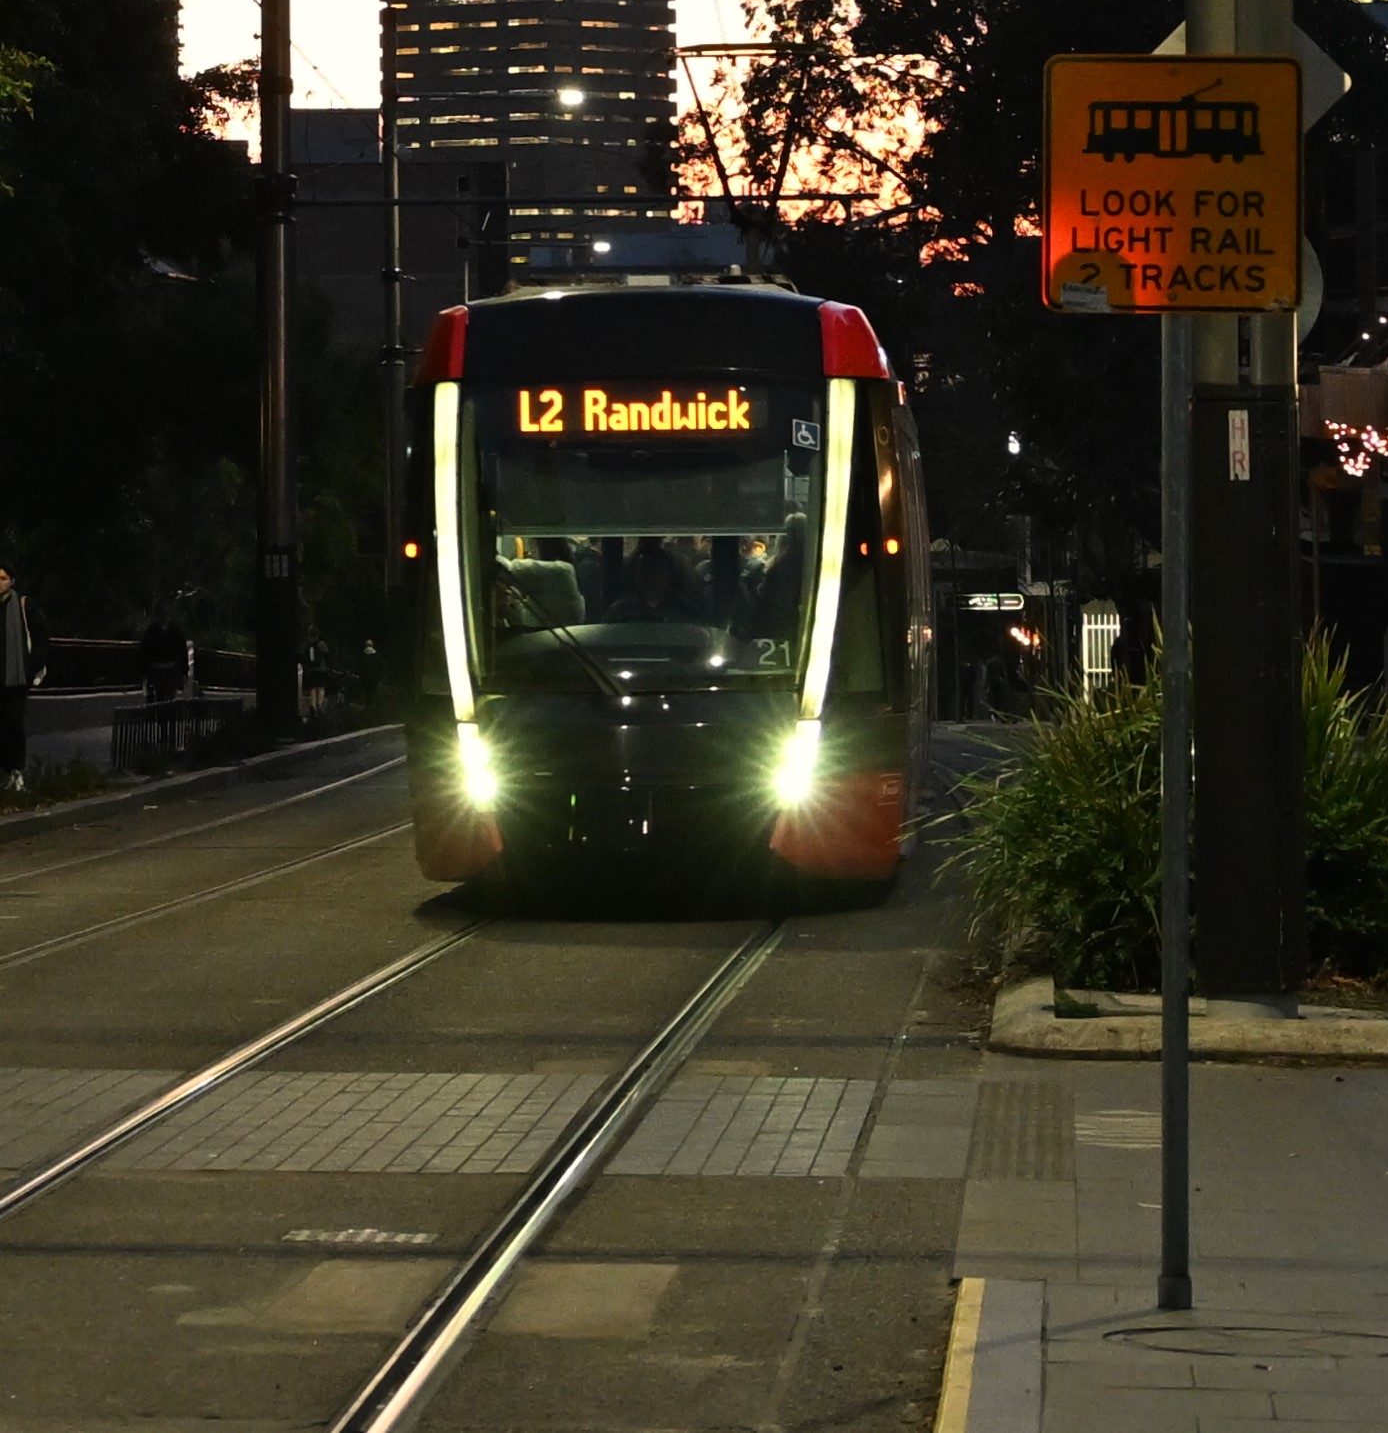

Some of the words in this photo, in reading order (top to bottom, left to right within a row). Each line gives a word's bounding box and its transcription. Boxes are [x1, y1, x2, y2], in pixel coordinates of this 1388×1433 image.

[1080, 189, 1176, 217] LOOK
[1194, 190, 1266, 217] FOR
[1071, 226, 1174, 254] LIGHT
[1190, 227, 1275, 255] RAIL
[1079, 262, 1102, 284] 2
[1118, 263, 1266, 292] TRACKS
[519, 389, 563, 432] L2
[583, 389, 750, 431] Randwick
[753, 637, 791, 668] 21
